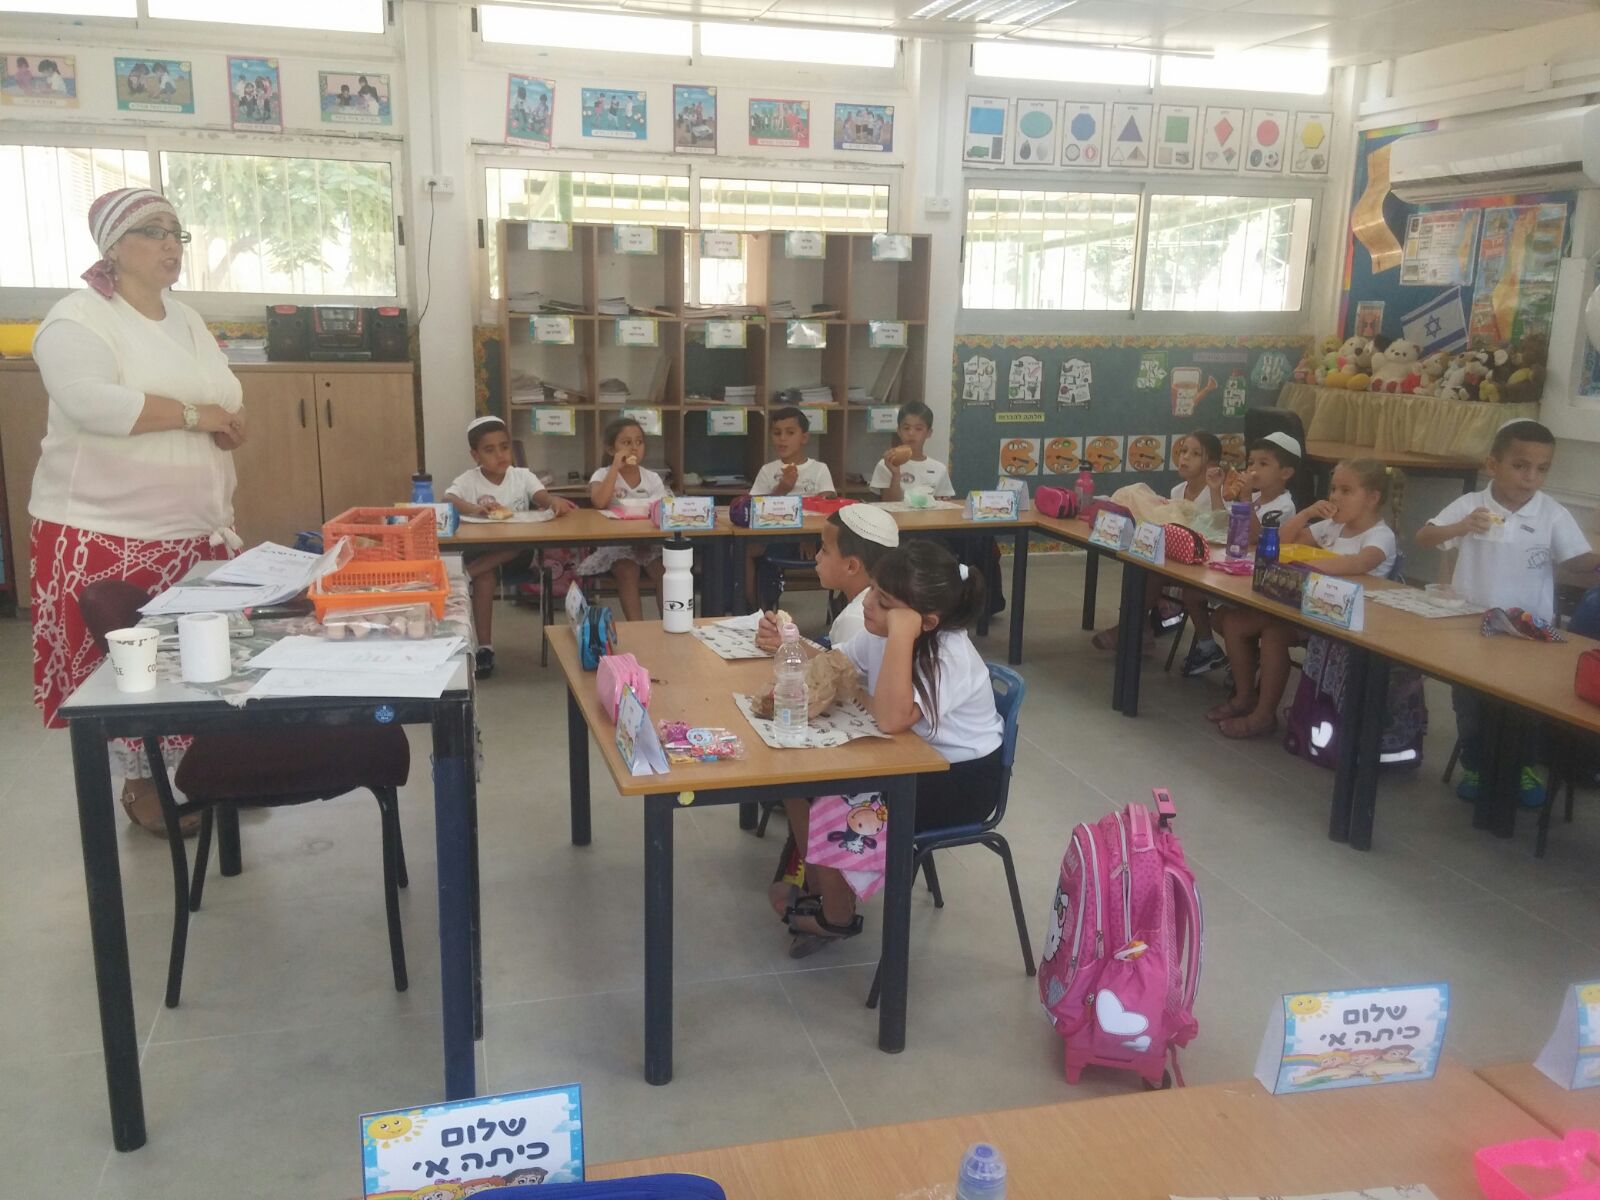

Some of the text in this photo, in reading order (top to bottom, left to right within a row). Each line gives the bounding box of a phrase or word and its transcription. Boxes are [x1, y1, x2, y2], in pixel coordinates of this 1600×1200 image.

[1342, 1003, 1407, 1025] שלום
[1354, 1026, 1420, 1044] כיתה
[441, 1117, 526, 1148] שלום
[460, 1142, 550, 1172] כיתה
